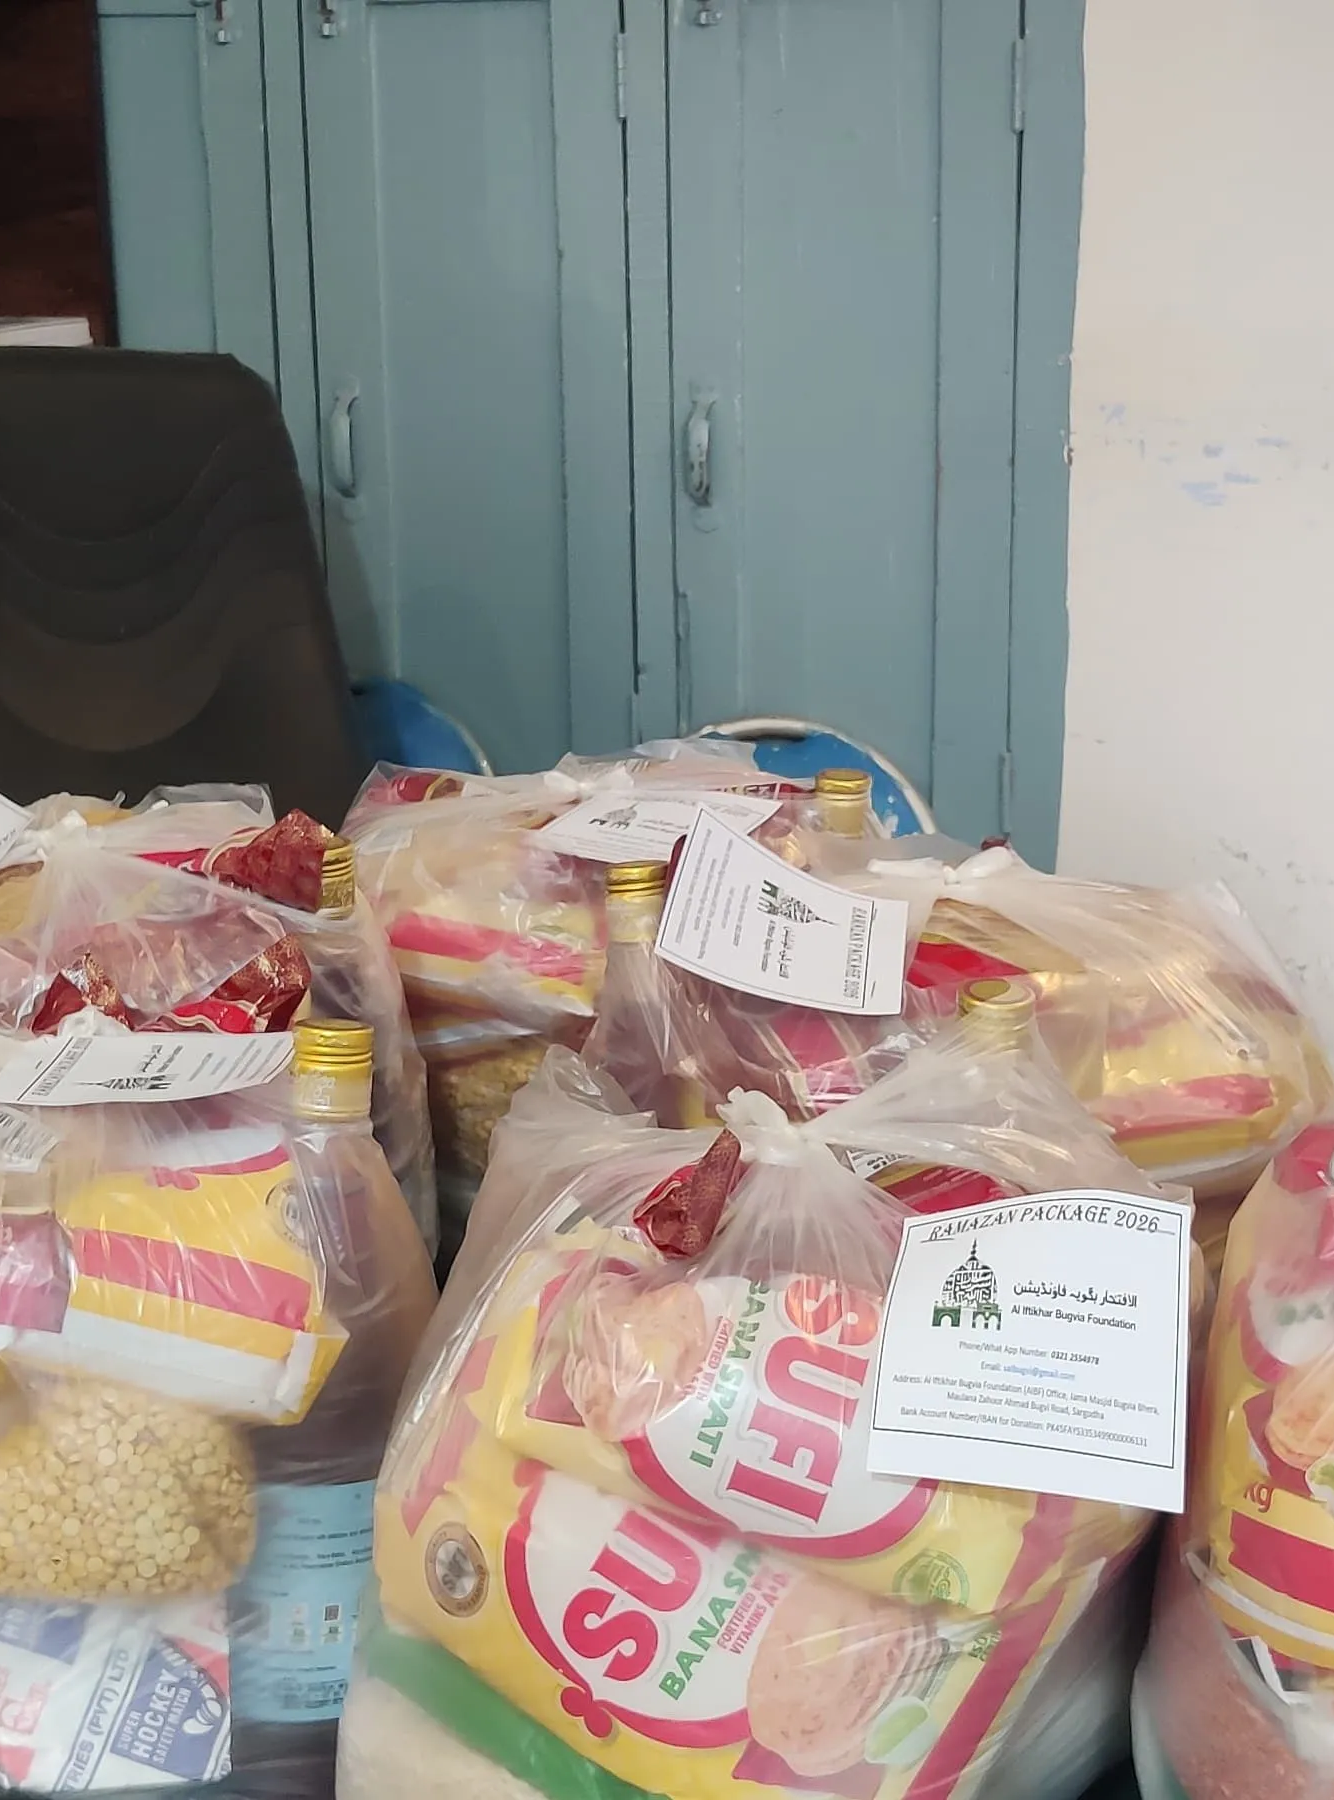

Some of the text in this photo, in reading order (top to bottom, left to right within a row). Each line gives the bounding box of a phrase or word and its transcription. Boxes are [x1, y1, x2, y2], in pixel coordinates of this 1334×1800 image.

[929, 1204, 1160, 1241] RAMAZAN PACKAGE 2026
[1010, 1305, 1137, 1331] Al Iftikhar Bugvia Foundation
[690, 1279, 771, 1469] BANASPATI
[959, 1341, 1003, 1353] Phone/What
[1004, 1344, 1018, 1356] App
[726, 1278, 880, 1524] SUFI
[892, 1374, 922, 1384] Address:
[983, 1380, 1023, 1393] Foundation
[1046, 1388, 1068, 1402] Office,
[900, 1406, 918, 1416] Bank
[918, 1408, 948, 1418] Account
[998, 1416, 1009, 1426] for
[563, 1509, 705, 1683] SU
[658, 1545, 764, 1701] BANASP
[717, 1591, 756, 1649] FORTIFIED
[729, 1603, 766, 1655] VITAMINS
[60, 1741, 95, 1790] TRIES
[87, 1688, 119, 1736] (PVT)
[117, 1709, 143, 1750] SUPER
[130, 1668, 180, 1759] HOCKEY
